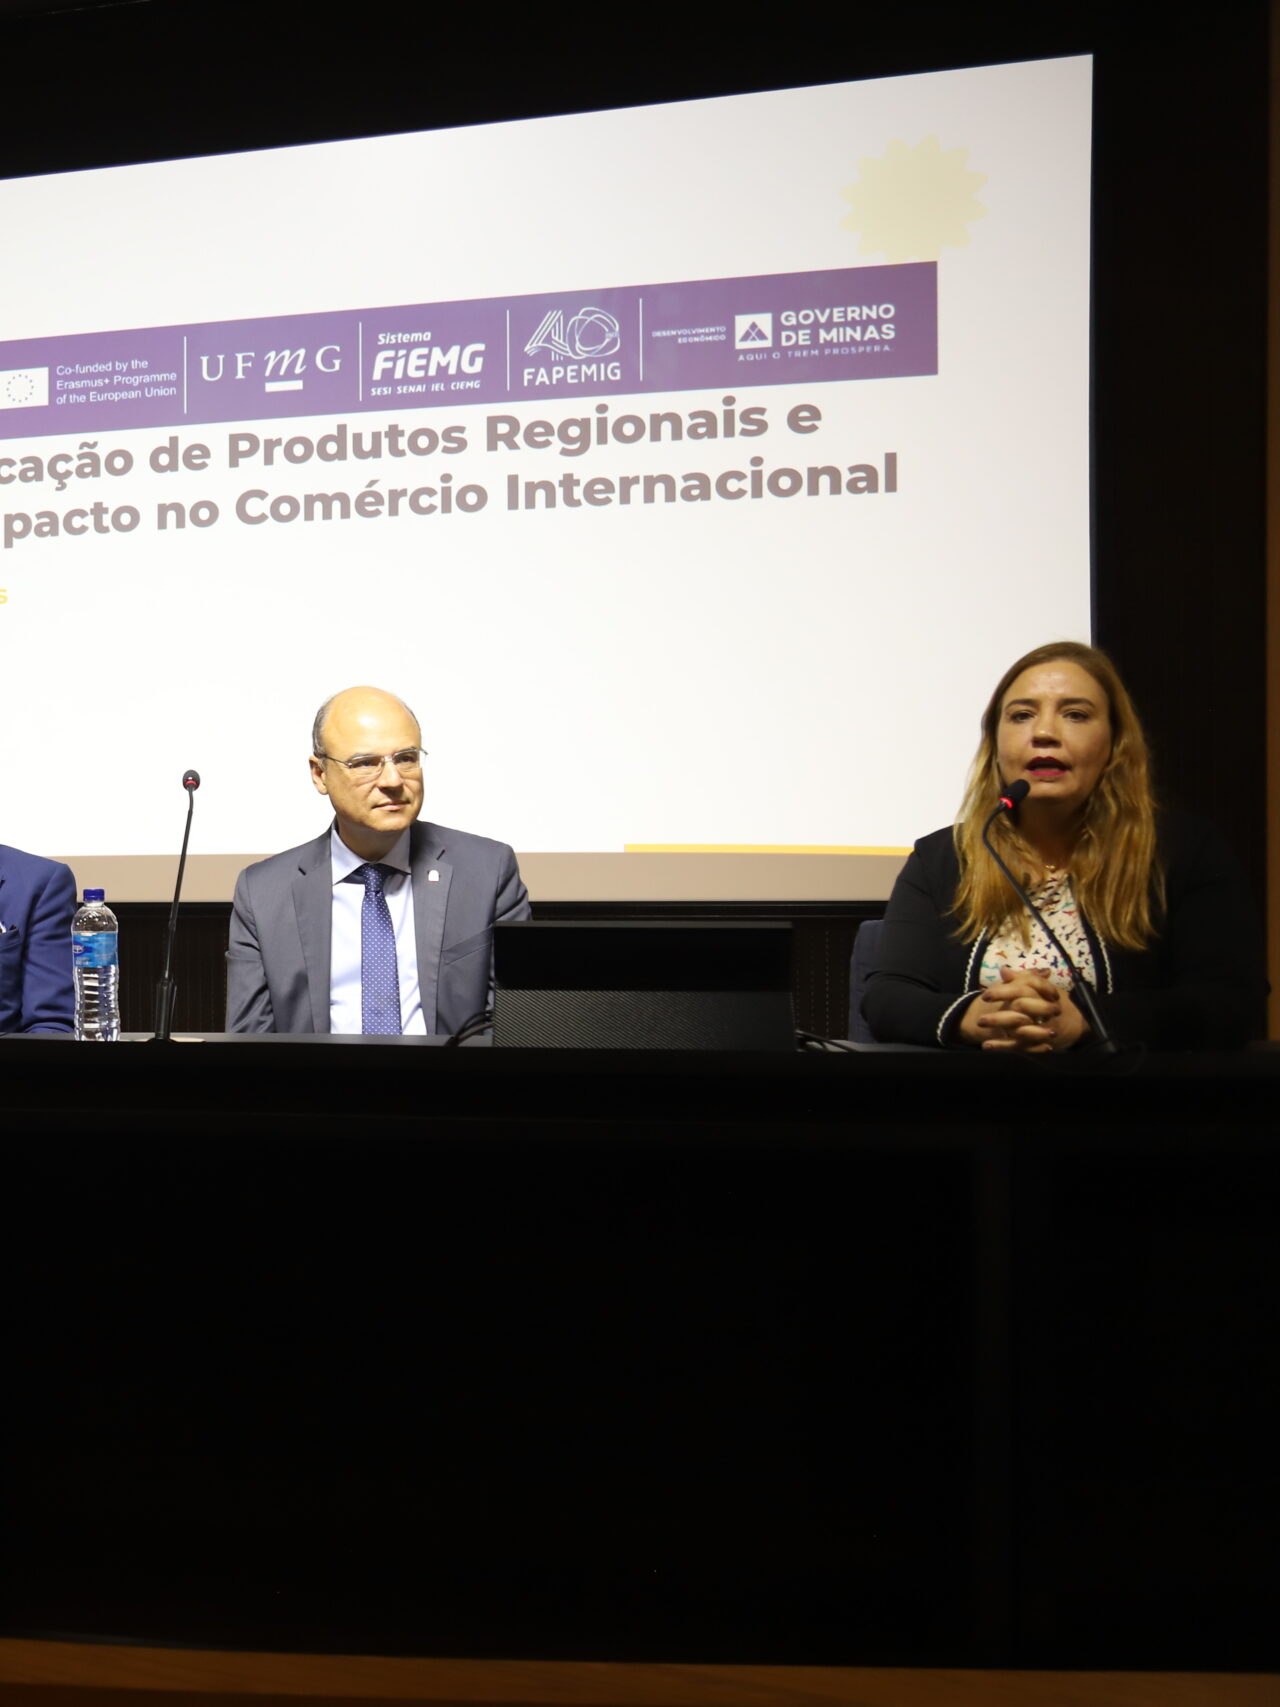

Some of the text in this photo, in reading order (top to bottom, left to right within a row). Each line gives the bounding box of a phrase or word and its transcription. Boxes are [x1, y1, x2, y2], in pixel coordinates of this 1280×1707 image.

[780, 304, 895, 326] GOVERNO
[377, 331, 432, 345] Sistema
[781, 324, 895, 346] DE MINAS
[737, 352, 767, 362] AQUI
[56, 359, 149, 376] Co-funded by the
[523, 362, 621, 387] FAPEMIG
[56, 372, 177, 391] Erasmus+ Programme
[370, 379, 481, 397] SESI SENAI IEL CIEMG
[56, 385, 177, 405] of the European Union
[149, 436, 211, 475] de
[228, 424, 468, 468] Produtos
[486, 395, 769, 456] Regionais
[786, 402, 822, 435] e
[157, 499, 219, 531] no
[235, 472, 488, 525] Comércio
[507, 452, 898, 510] Internacional
